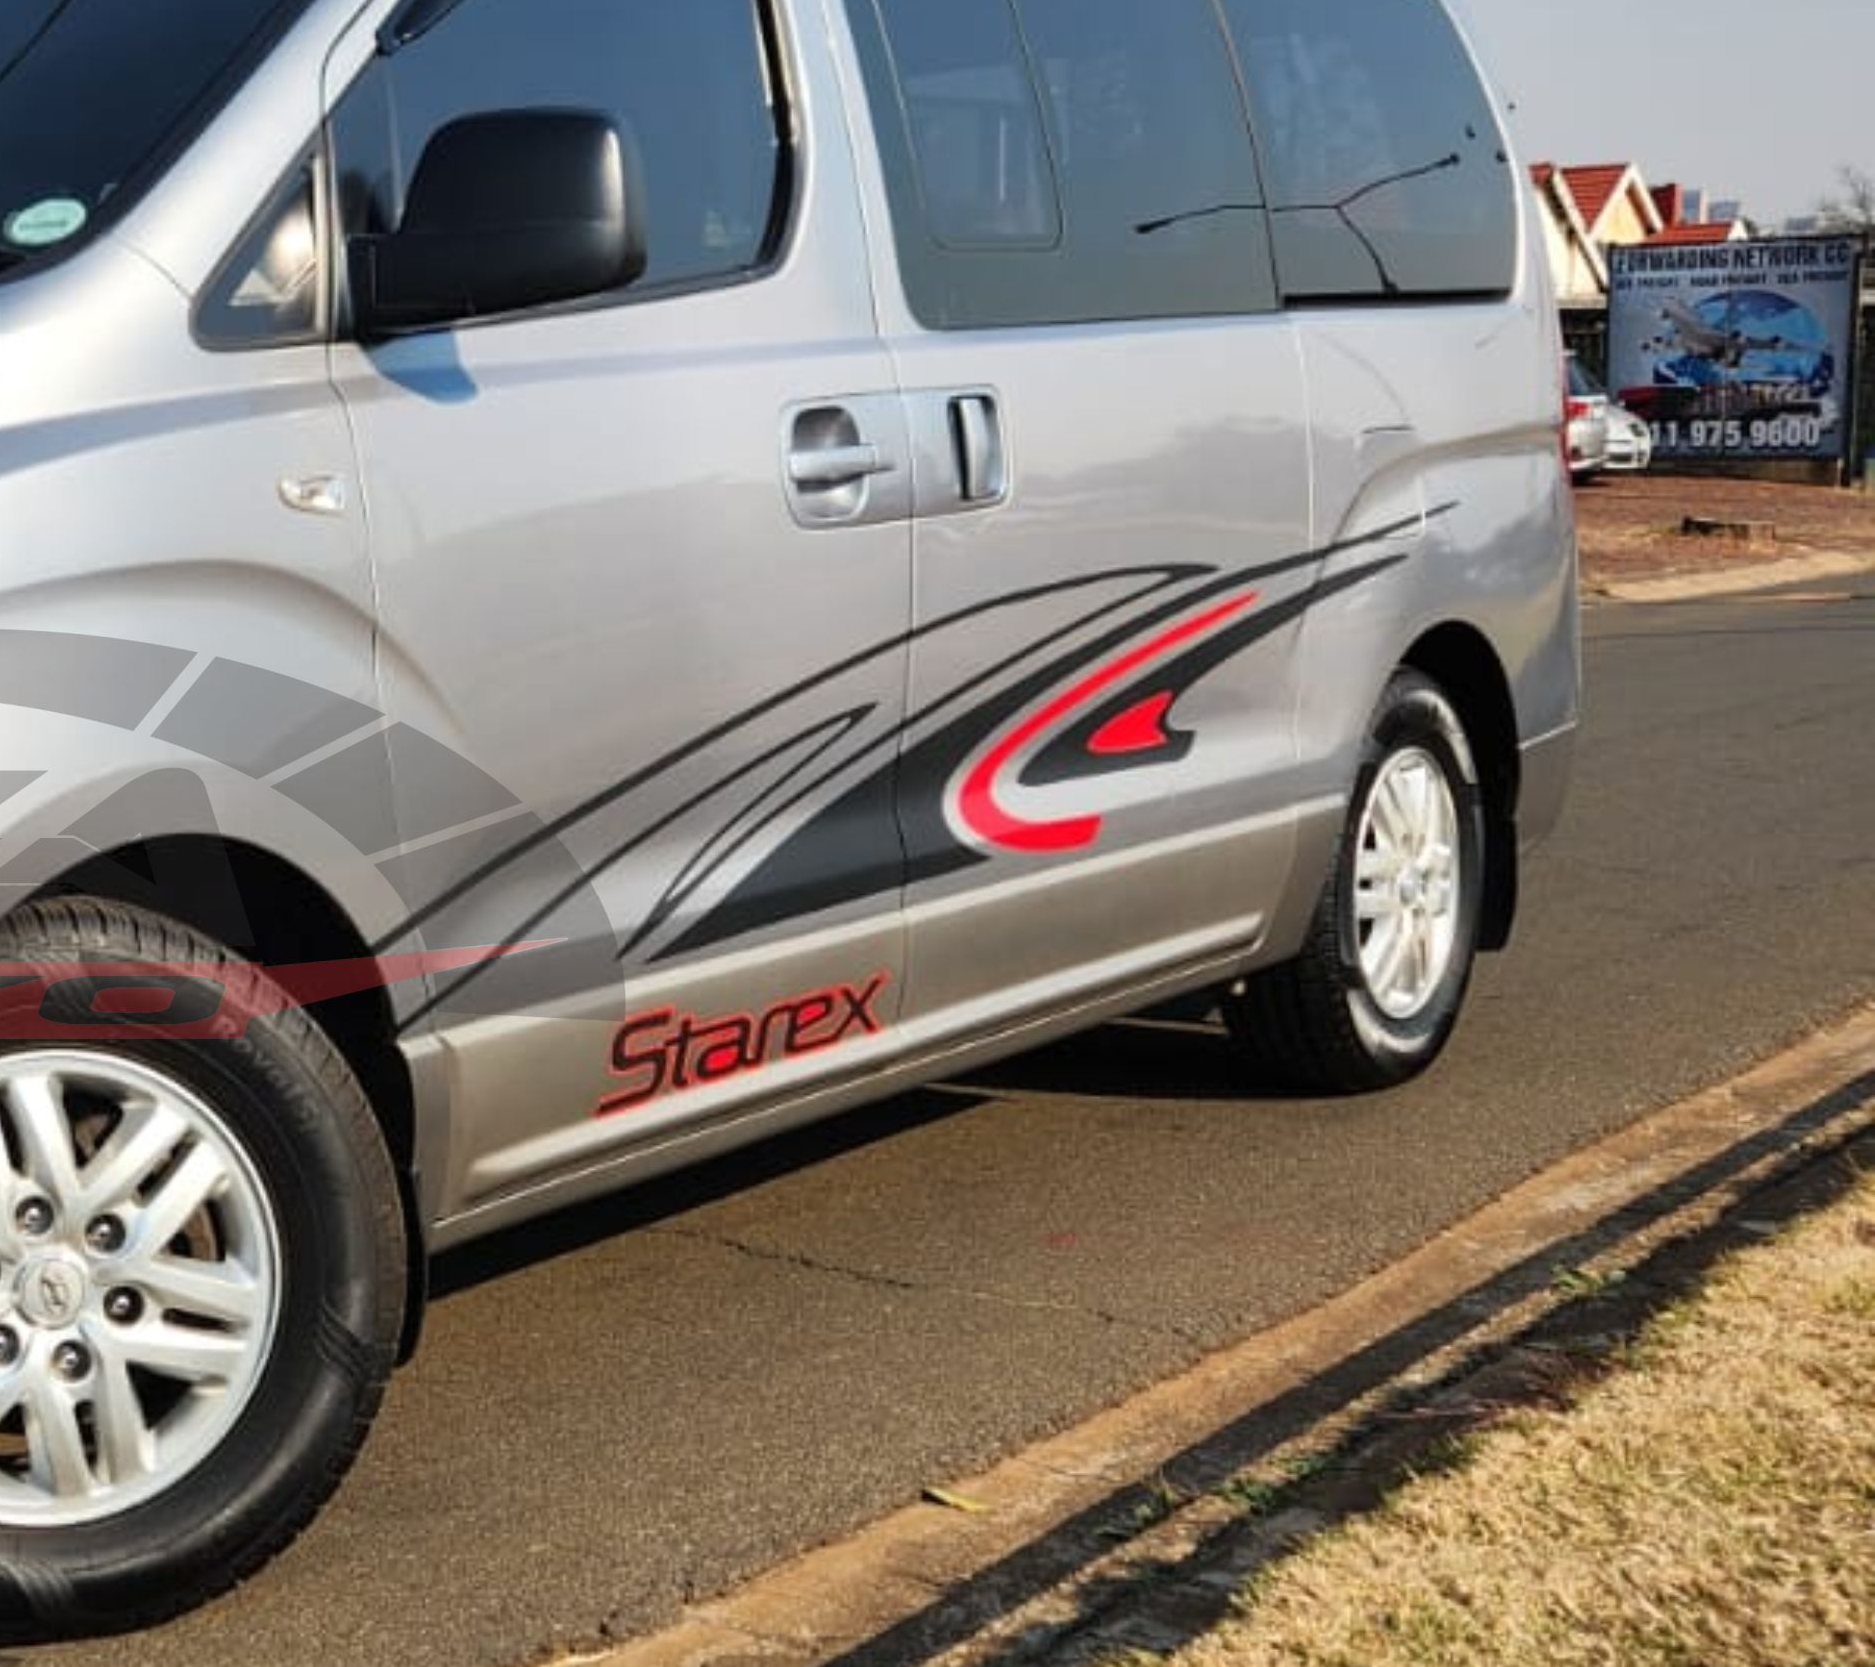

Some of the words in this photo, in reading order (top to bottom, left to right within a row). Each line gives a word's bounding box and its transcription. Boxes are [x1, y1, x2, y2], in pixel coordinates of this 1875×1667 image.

[1690, 420, 1742, 448] 975
[1749, 419, 1821, 448] 9600
[595, 970, 890, 1119] Starex
